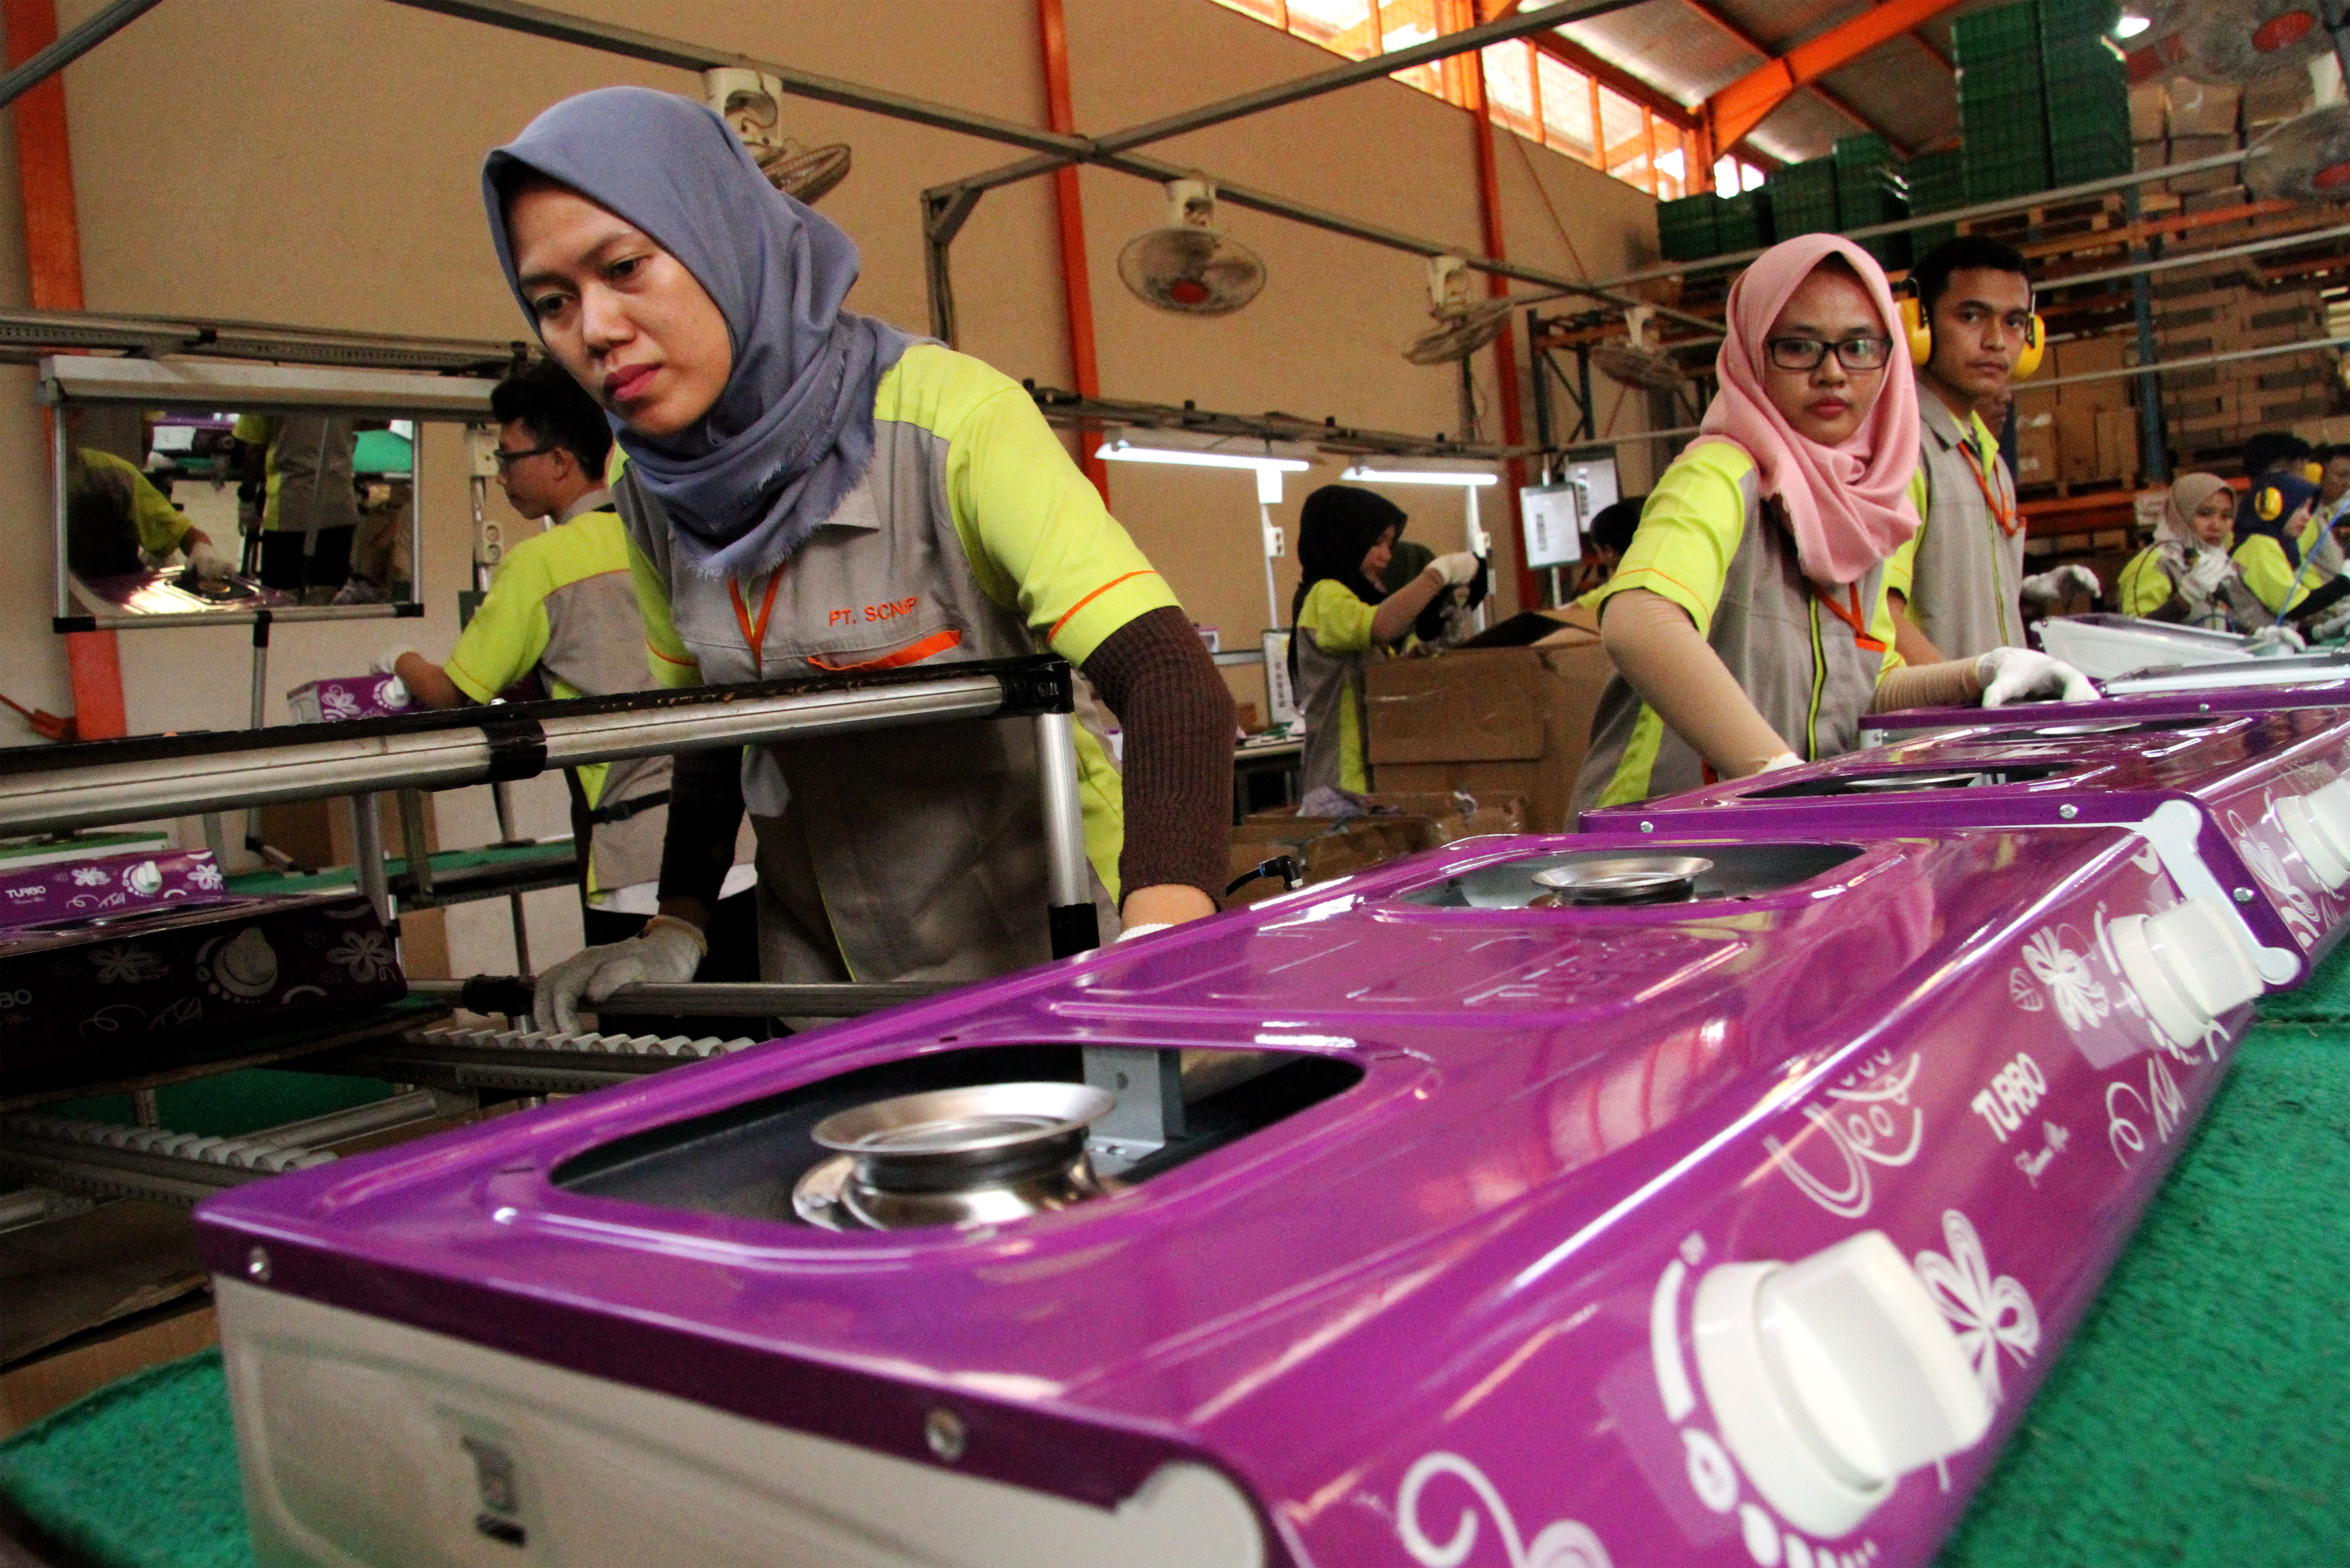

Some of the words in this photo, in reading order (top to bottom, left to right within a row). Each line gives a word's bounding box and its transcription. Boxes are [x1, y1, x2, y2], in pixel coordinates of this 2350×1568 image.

[829, 608, 857, 626] PT.
[864, 596, 917, 622] SCNP
[5, 885, 46, 898] TURBO
[1970, 1052, 2047, 1143] TURBO
